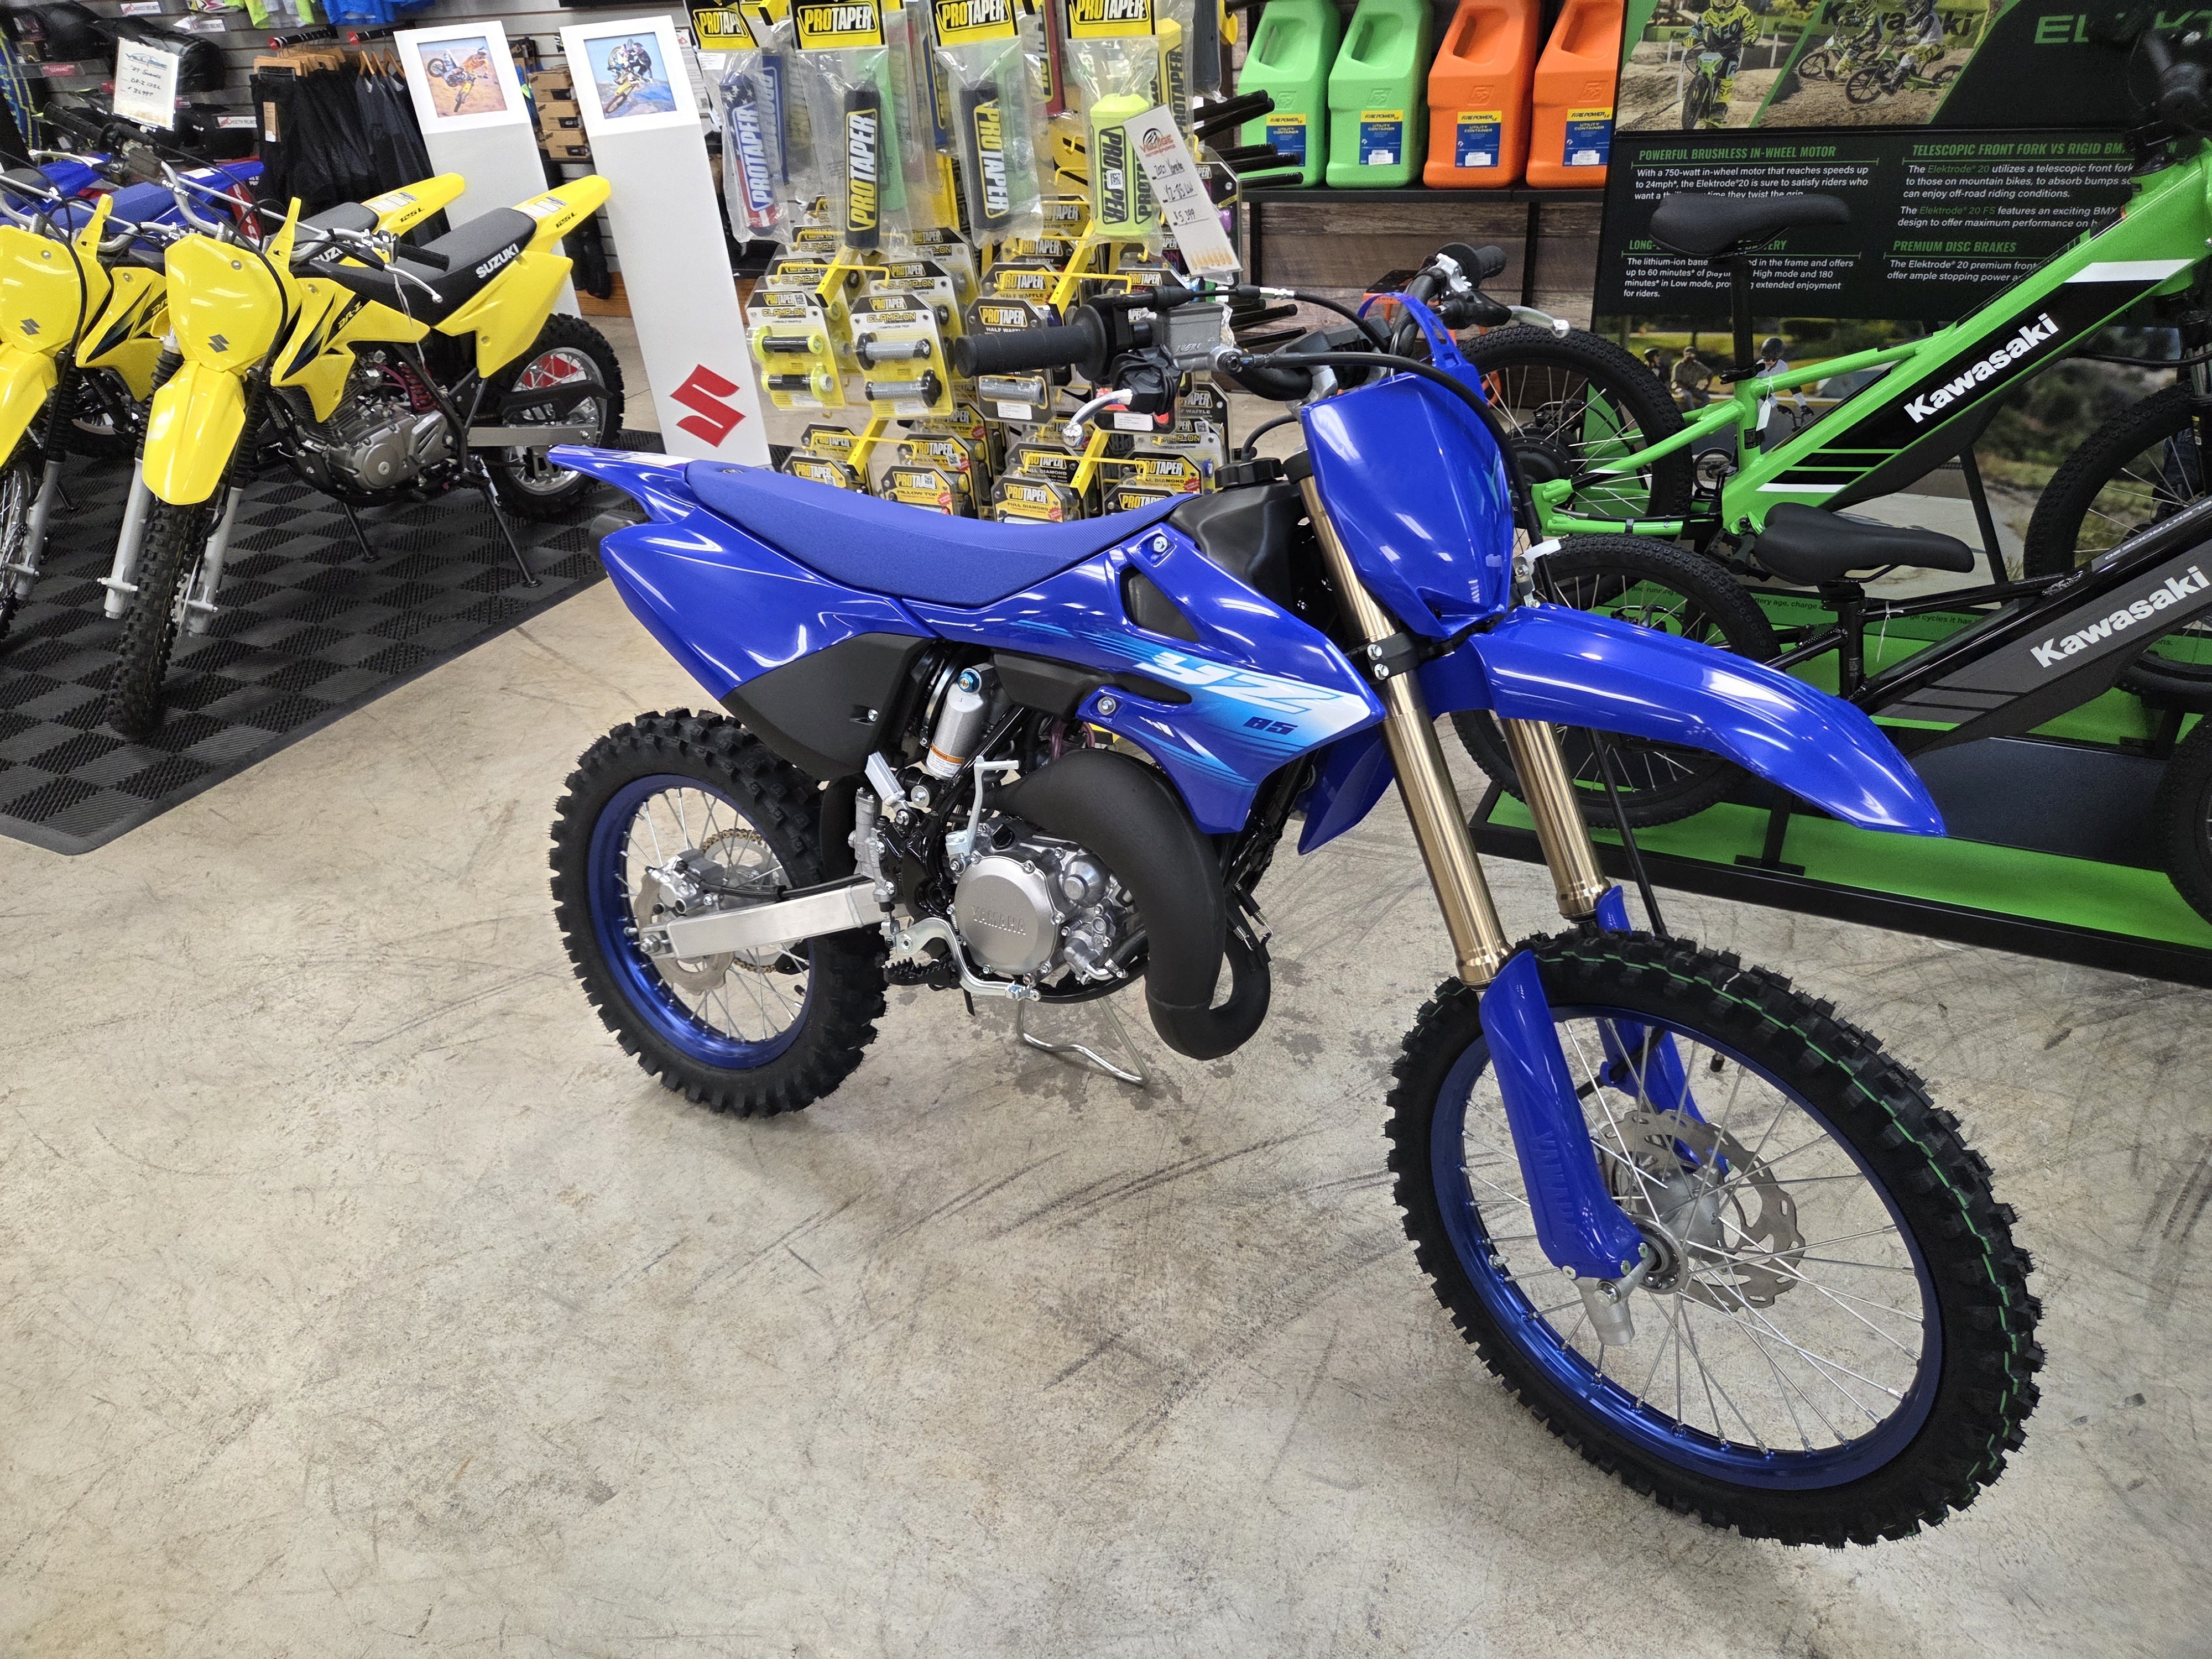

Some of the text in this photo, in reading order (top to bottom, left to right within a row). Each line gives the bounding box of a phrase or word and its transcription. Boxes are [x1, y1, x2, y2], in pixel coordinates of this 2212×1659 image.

[804, 6, 874, 33] PROTAPER
[942, 0, 1008, 27] PROTAPER
[1639, 146, 1836, 160] POWERFUL BRUSHLESS IN-WHEEL MOTOR
[1913, 143, 2101, 156] TELESCOPIC FRONT FORK VS RIGID
[849, 114, 877, 227] PROTAPER
[1665, 168, 1700, 176] 750-watt
[1702, 168, 1738, 176] in-wheel
[1767, 166, 1785, 175] that
[1786, 166, 1820, 174] reaches
[1823, 166, 1854, 175] speeds
[1992, 164, 2025, 173] utilizes
[2036, 164, 2086, 174] telescopic
[2088, 163, 2111, 173] front
[1791, 178, 1819, 187] satisfy
[1821, 178, 1846, 186] riders
[1849, 178, 1869, 186] who
[1917, 177, 1942, 185] those
[1959, 177, 2003, 185] mountain
[2005, 176, 2033, 186] bikes,
[2048, 176, 2082, 185] absorb
[2084, 176, 2119, 186] bumps
[1922, 190, 1947, 200] enjoy
[1949, 189, 1986, 197] off-road
[1988, 189, 2016, 199] riding
[2017, 189, 2070, 198] conditions.
[1901, 206, 1917, 215] The
[1997, 206, 2036, 215] features
[2053, 206, 2090, 217] exciting
[1897, 218, 1928, 228] design
[1942, 217, 1963, 226] offer
[1965, 218, 2010, 227] maximum
[2012, 218, 2074, 228] performance
[1893, 241, 2017, 253] PREMIUM DISC BRAKES
[476, 243, 520, 279] SUZUKI
[1970, 261, 2011, 270] premium
[891, 264, 923, 276] PROTAPER
[1752, 270, 1772, 279] High
[1910, 272, 1937, 281] ample
[1939, 273, 1978, 282] stopping
[1689, 280, 1714, 288] mode,
[1796, 281, 1841, 291] enjoyment
[873, 298, 904, 310] PROTAPER
[338, 301, 363, 330] DR-Z
[762, 309, 806, 318] CLAMP-ON
[867, 312, 916, 323] CLAMP-ON
[983, 309, 1024, 325] PROTAPER
[1903, 312, 2059, 423] Kawasaki
[1007, 486, 1047, 503] PROTAPER
[1791, 601, 1817, 609] charge
[2030, 565, 2211, 668] Kawasaki
[1242, 716, 1298, 735] 85
[972, 905, 1026, 936] YAMAHA
